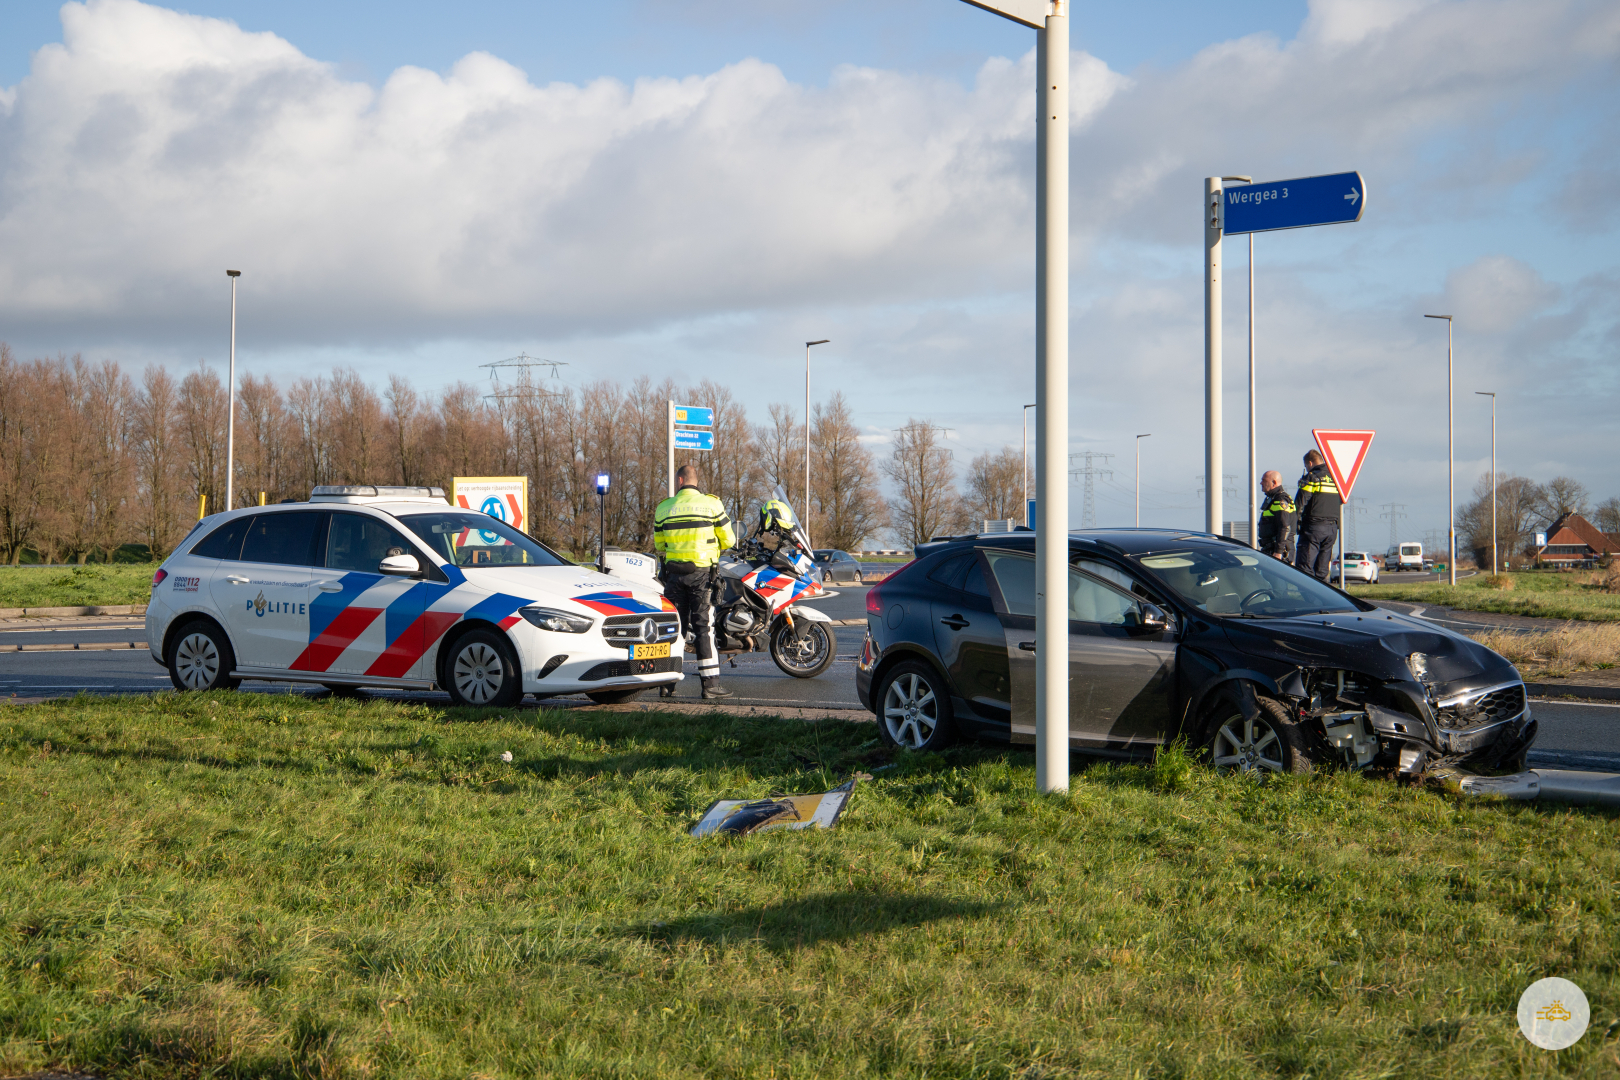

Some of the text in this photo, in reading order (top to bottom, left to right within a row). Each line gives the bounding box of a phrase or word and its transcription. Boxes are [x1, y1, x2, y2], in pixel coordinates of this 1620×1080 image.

[1228, 188, 1289, 204] Wergea 3
[626, 557, 643, 566] 1623
[187, 577, 200, 586] 112
[246, 599, 306, 617] POLITIE
[638, 645, 667, 657] S-721-RG
